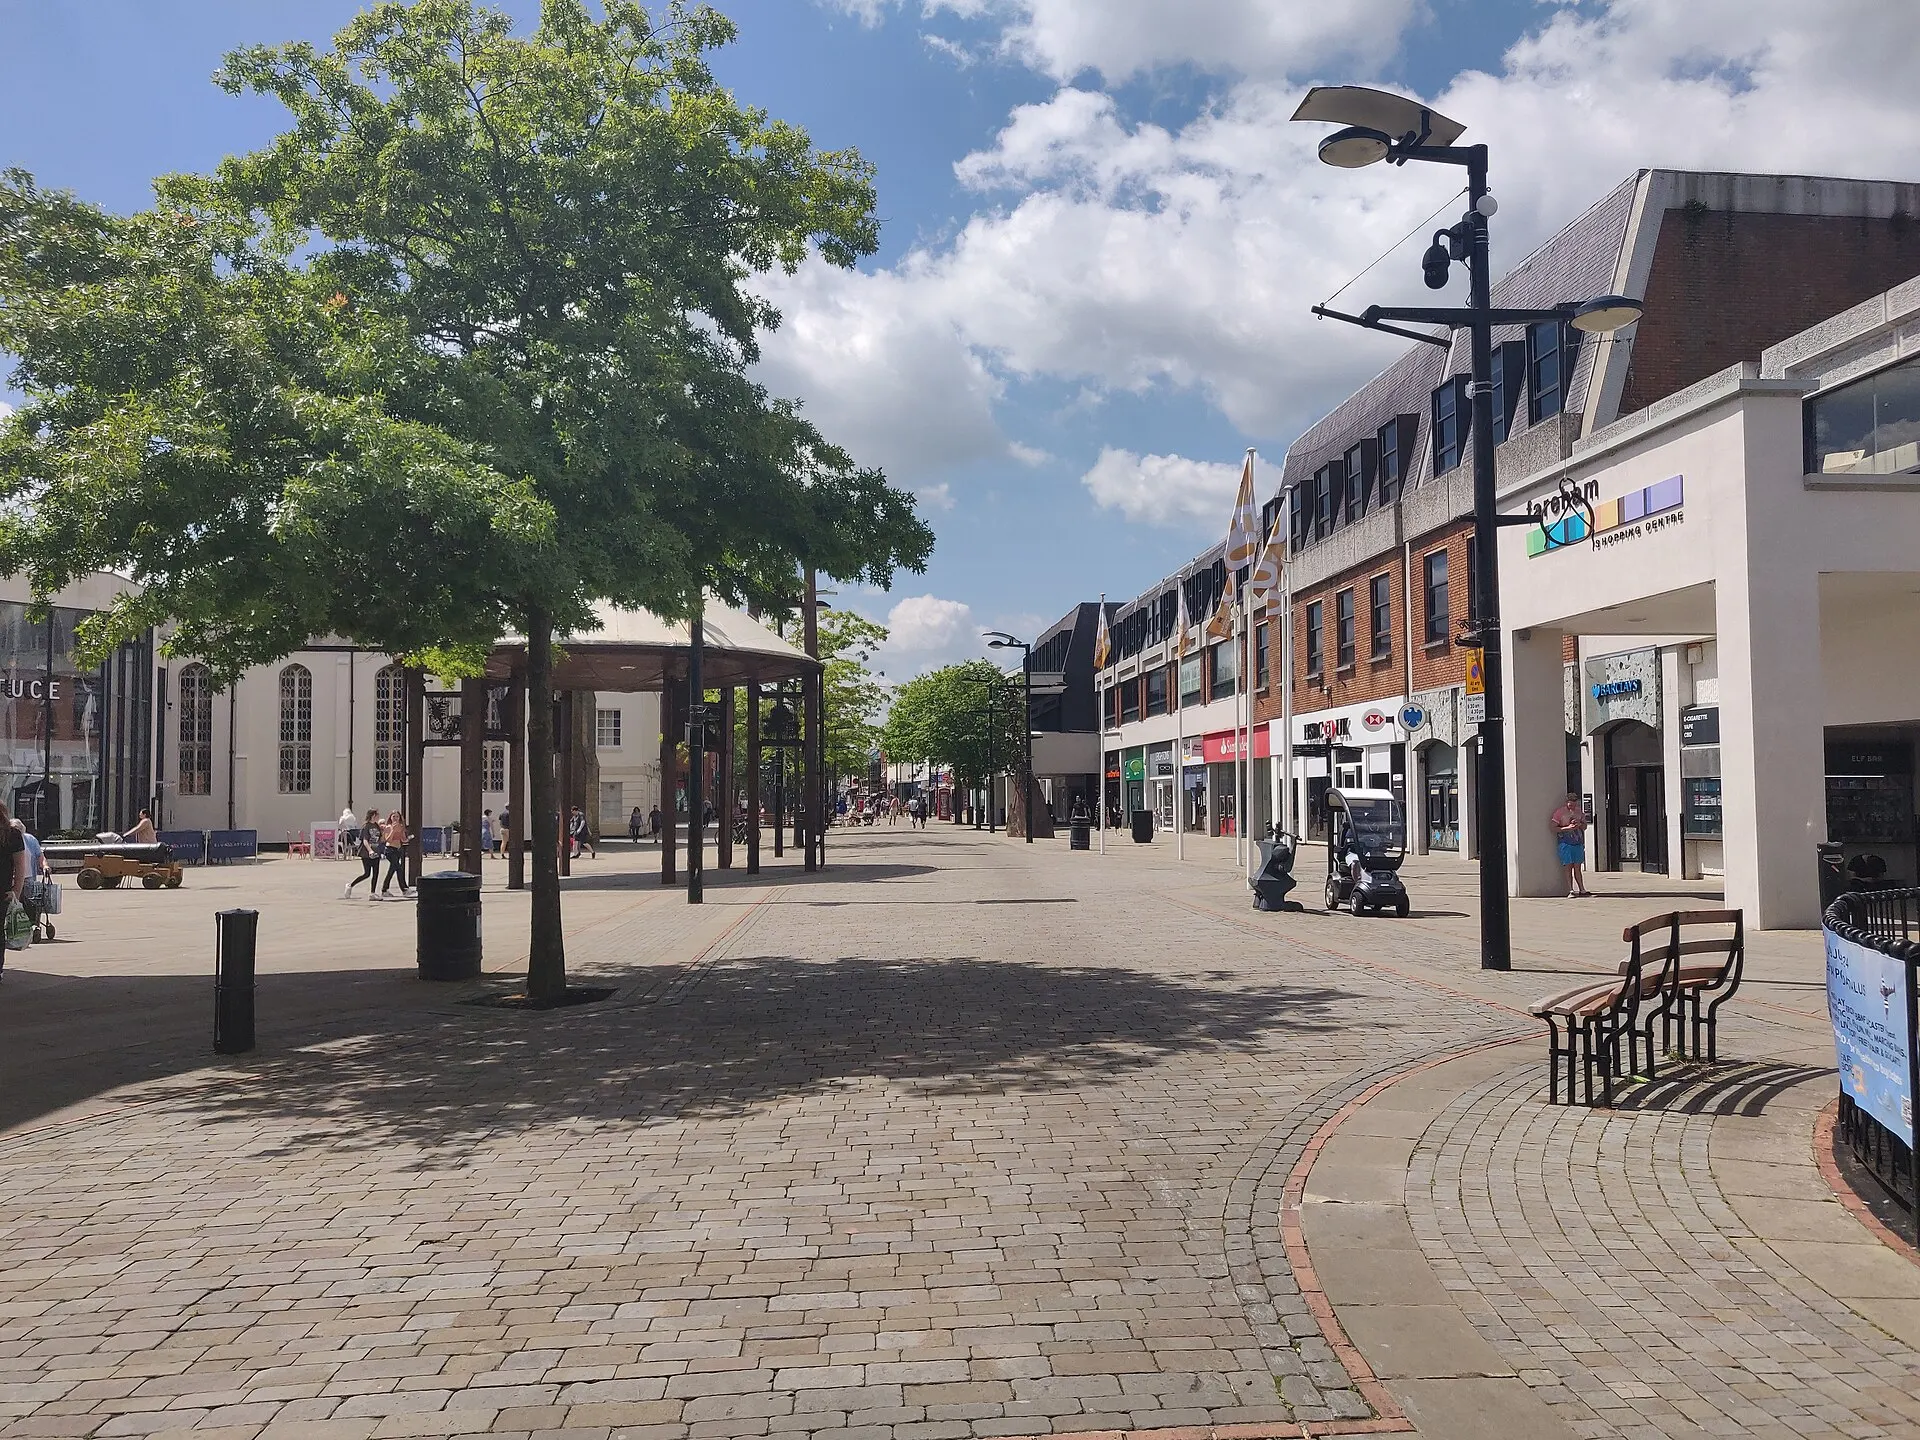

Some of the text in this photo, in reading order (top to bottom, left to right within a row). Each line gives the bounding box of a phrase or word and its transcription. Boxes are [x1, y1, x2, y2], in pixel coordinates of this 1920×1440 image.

[1594, 511, 1684, 548] SHOPPING CENTRE
[1600, 680, 1638, 696] BARCLAYS
[1683, 714, 1708, 722] E-CIGARETTE
[1335, 718, 1350, 736] UK
